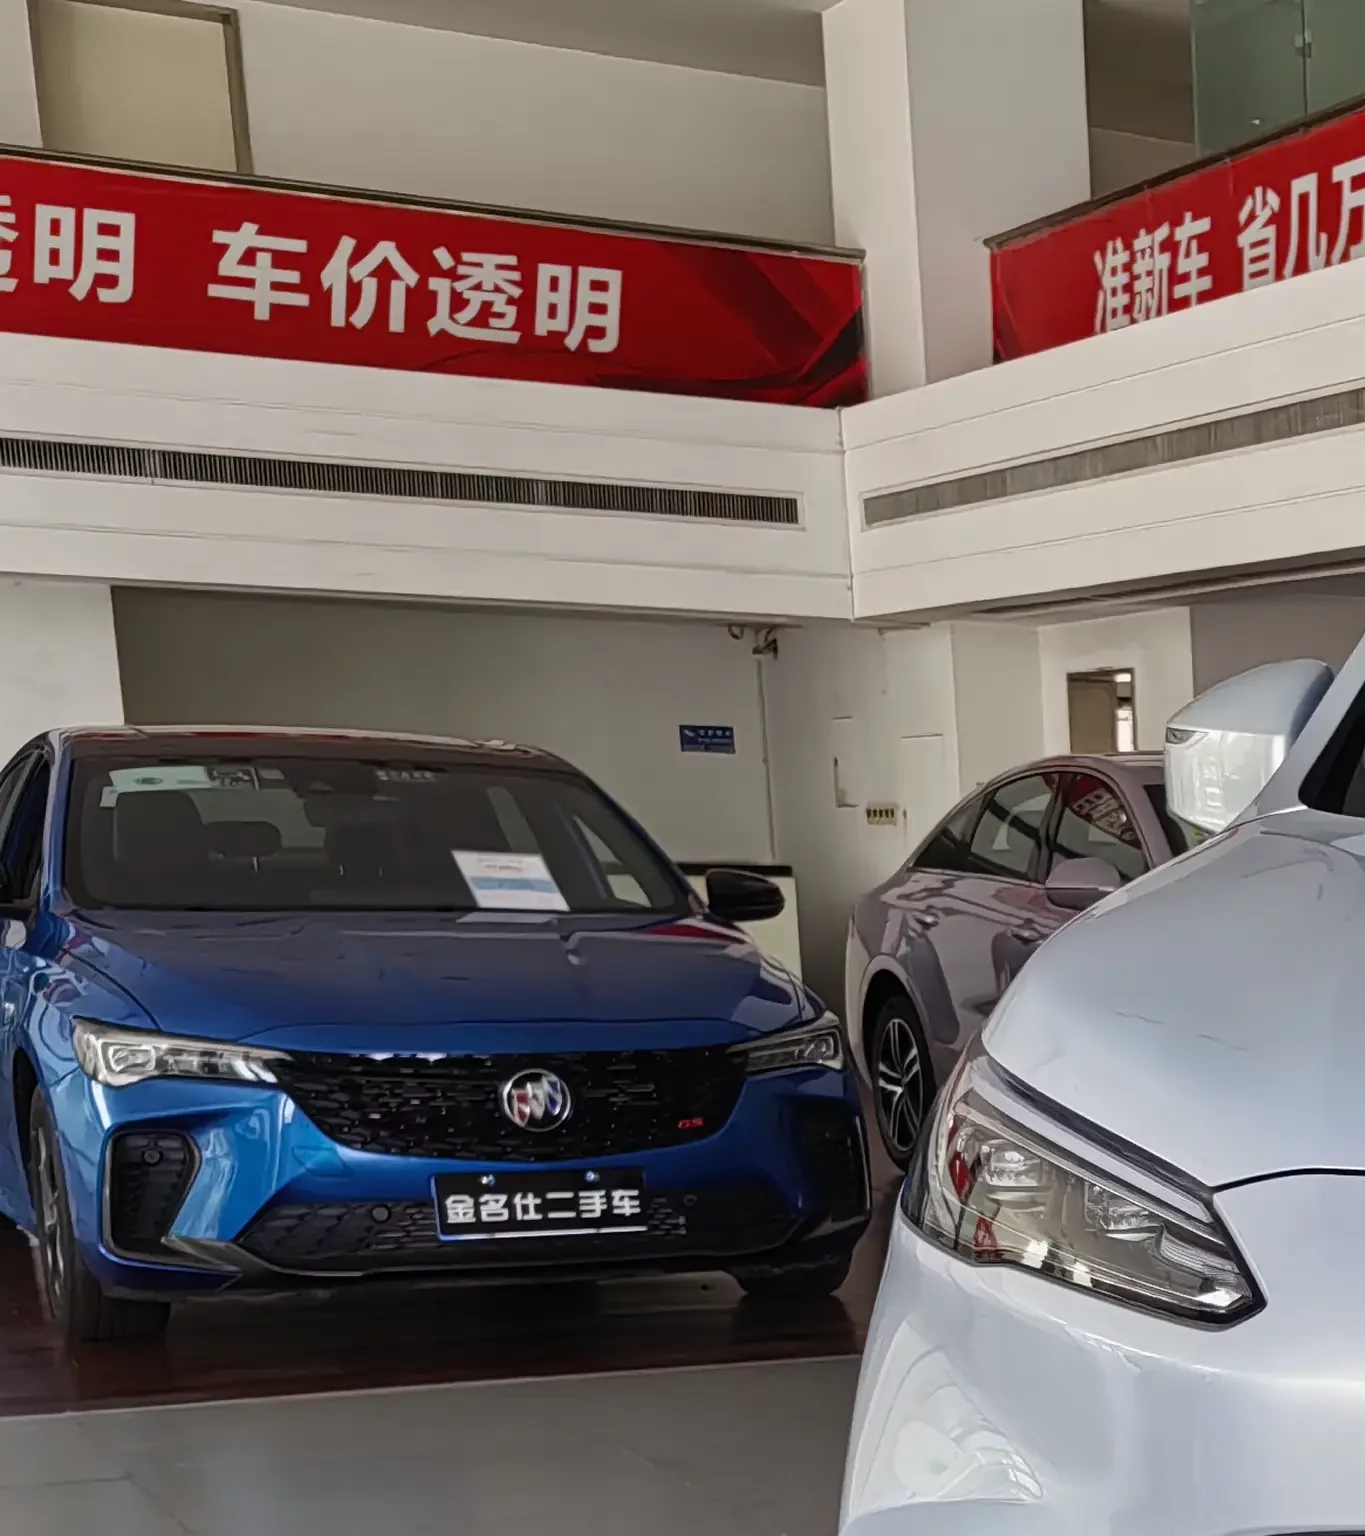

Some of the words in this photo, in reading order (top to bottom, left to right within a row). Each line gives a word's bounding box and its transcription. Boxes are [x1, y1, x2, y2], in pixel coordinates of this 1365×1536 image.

[0, 194, 136, 303] 明
[207, 222, 624, 354] 车价透明
[1093, 212, 1214, 333] 准新车
[445, 1189, 642, 1224] 金名仕二手车
